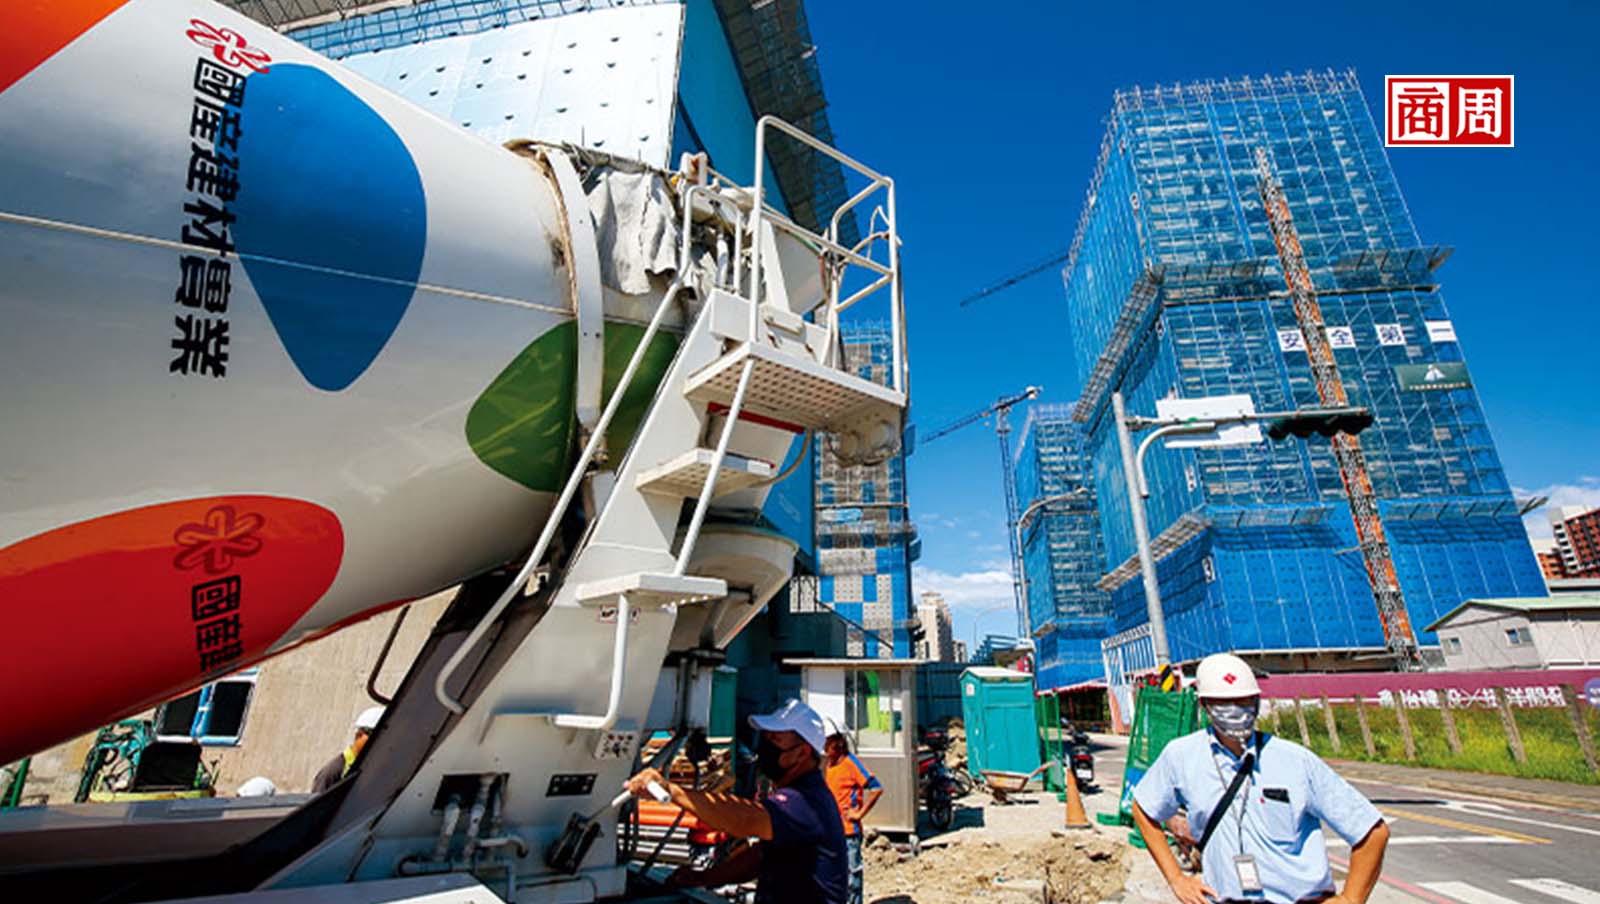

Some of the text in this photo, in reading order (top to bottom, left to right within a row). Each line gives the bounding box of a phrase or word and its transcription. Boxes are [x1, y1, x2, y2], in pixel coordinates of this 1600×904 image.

[169, 56, 247, 379] 國產建材實業
[1280, 324, 1453, 349] 安全第一
